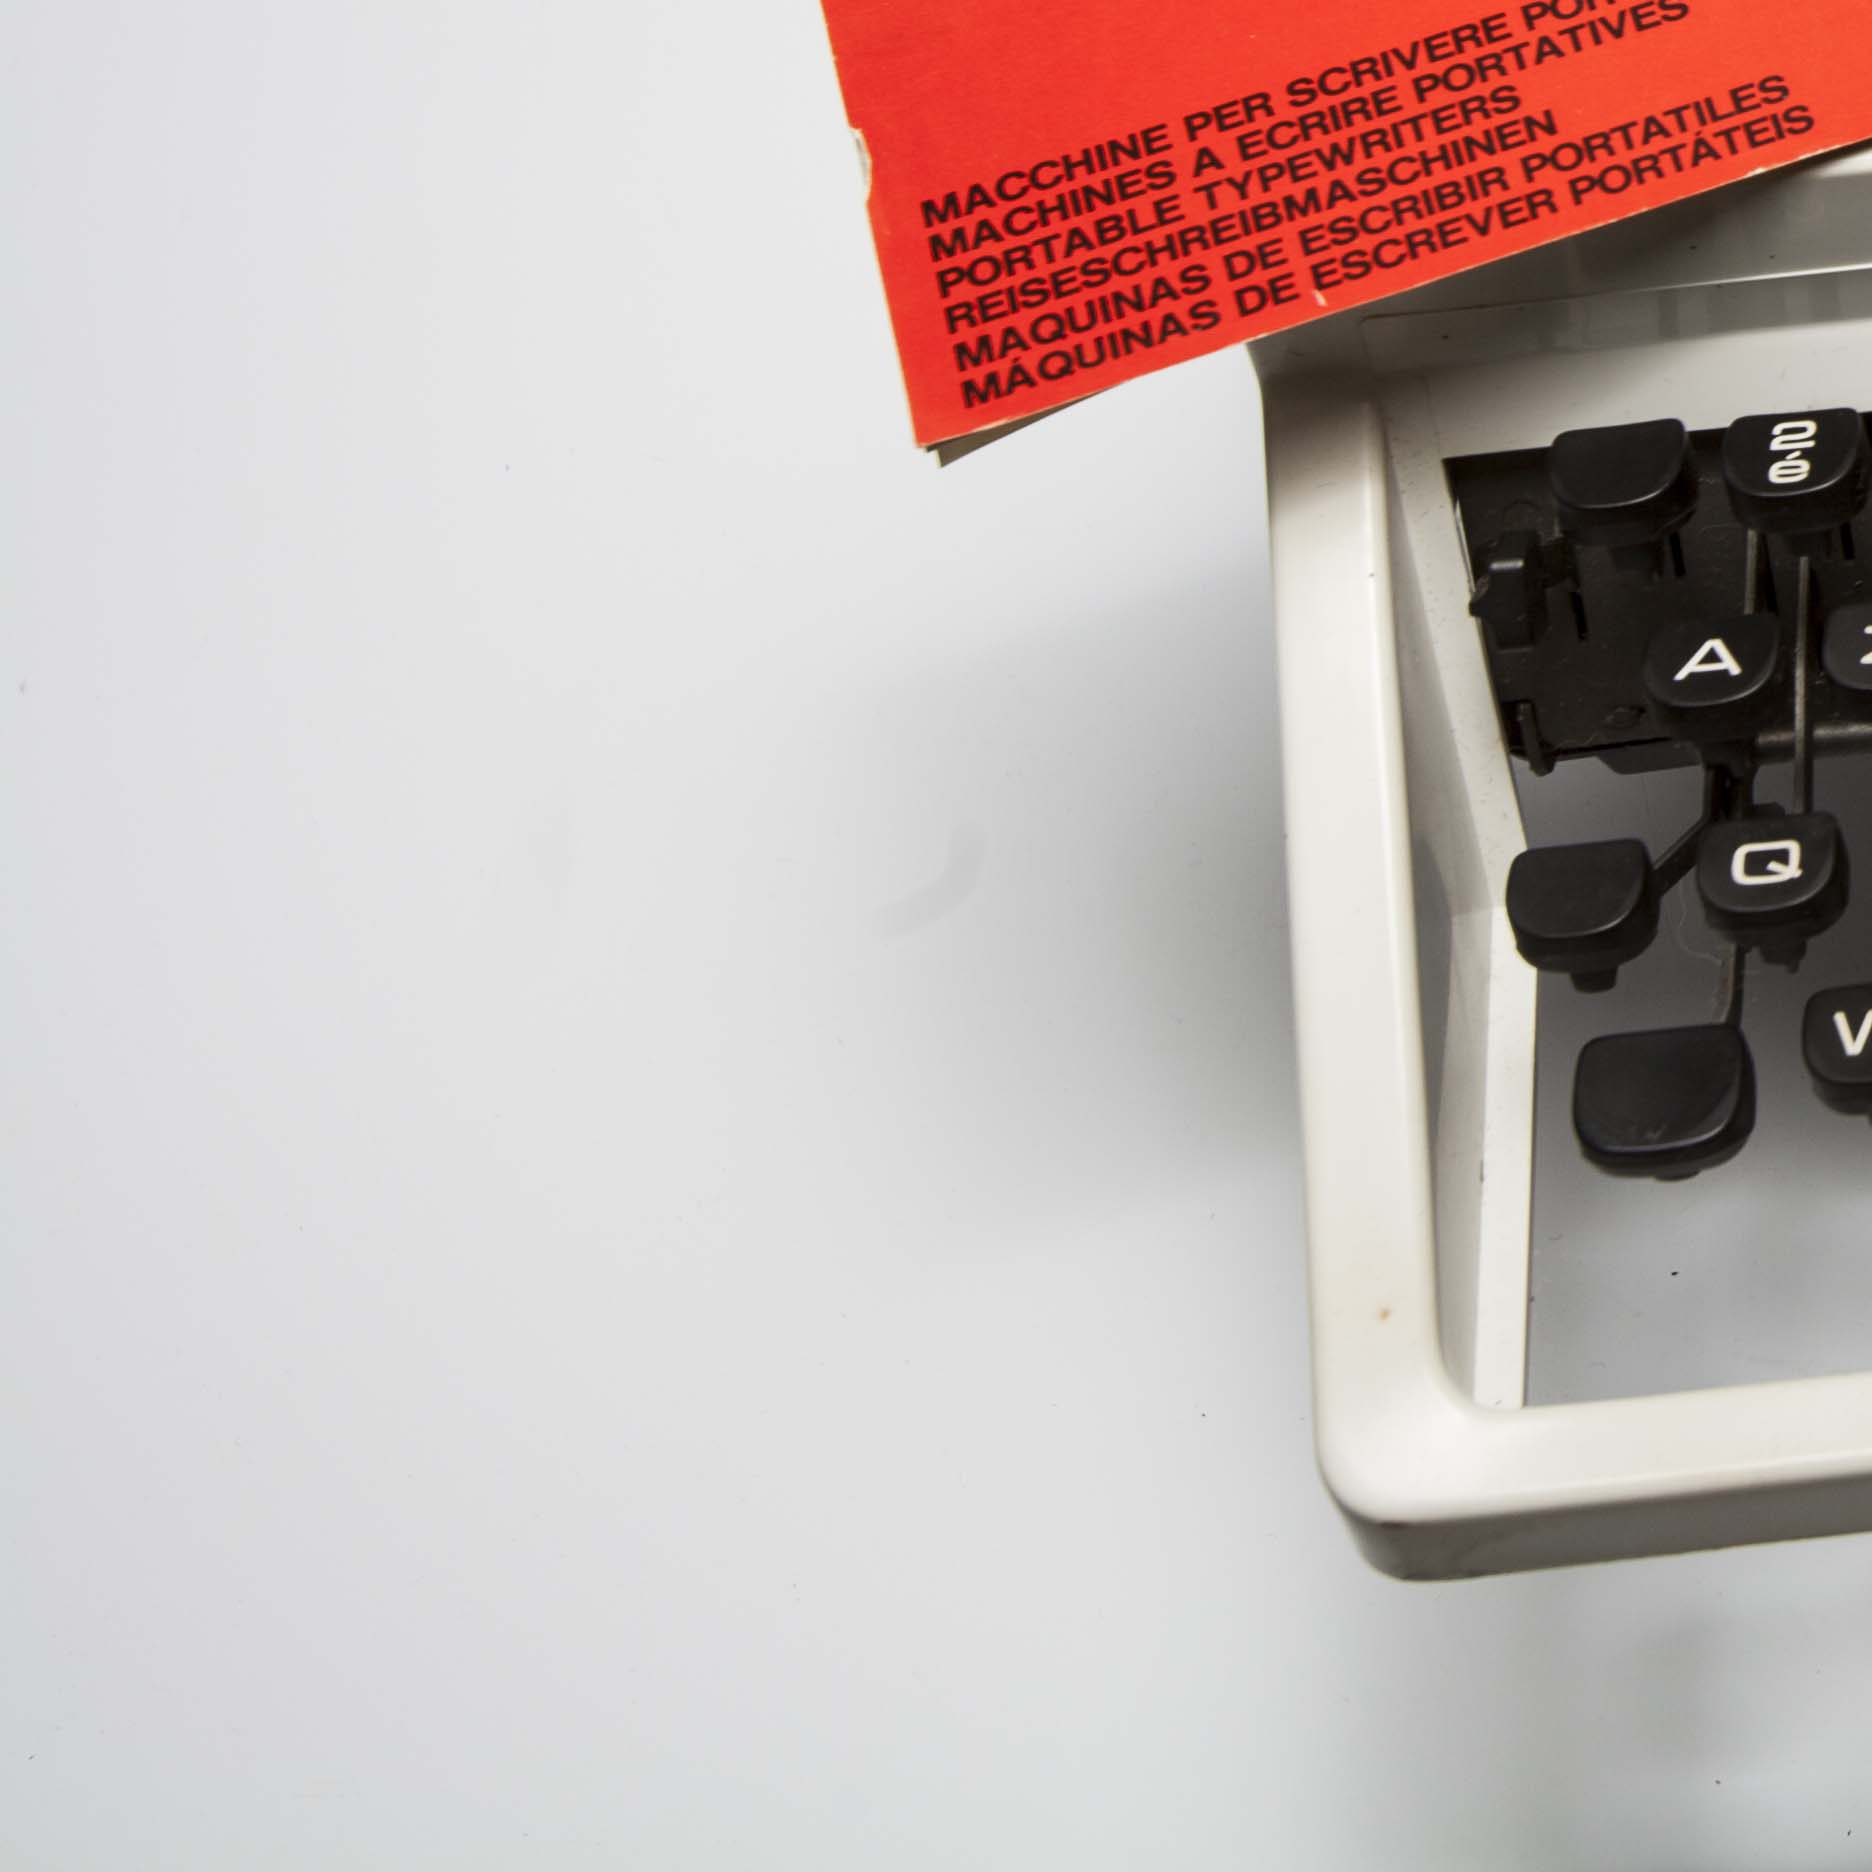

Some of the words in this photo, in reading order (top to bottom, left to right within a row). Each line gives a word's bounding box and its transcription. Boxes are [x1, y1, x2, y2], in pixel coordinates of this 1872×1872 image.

[919, 122, 1173, 228] MACCHINE
[1182, 91, 1275, 142] PER
[1285, 11, 1513, 108] SCRIVERE
[927, 159, 1177, 263] MACHINES
[1192, 145, 1225, 178] A
[1235, 84, 1403, 162] ECRIRE
[935, 193, 1185, 299] PORTABLE
[1192, 84, 1521, 210] TYPEWRITERS
[943, 108, 1558, 335] REISESCHREIBMASCHINEN
[952, 263, 1212, 372] MAQUINAS
[1222, 237, 1288, 282] DE
[1297, 165, 1510, 257] ESCRIBIR
[1519, 74, 1790, 183] PORTATILES
[960, 298, 1221, 409] MÁQUINAS
[1233, 271, 1300, 317] DE
[1309, 187, 1558, 292] ESCREVER
[1567, 104, 1814, 206] PORTÁTEIS
[1770, 420, 1816, 450] 2
[1675, 639, 1741, 680] A
[1731, 840, 1802, 885] Q
